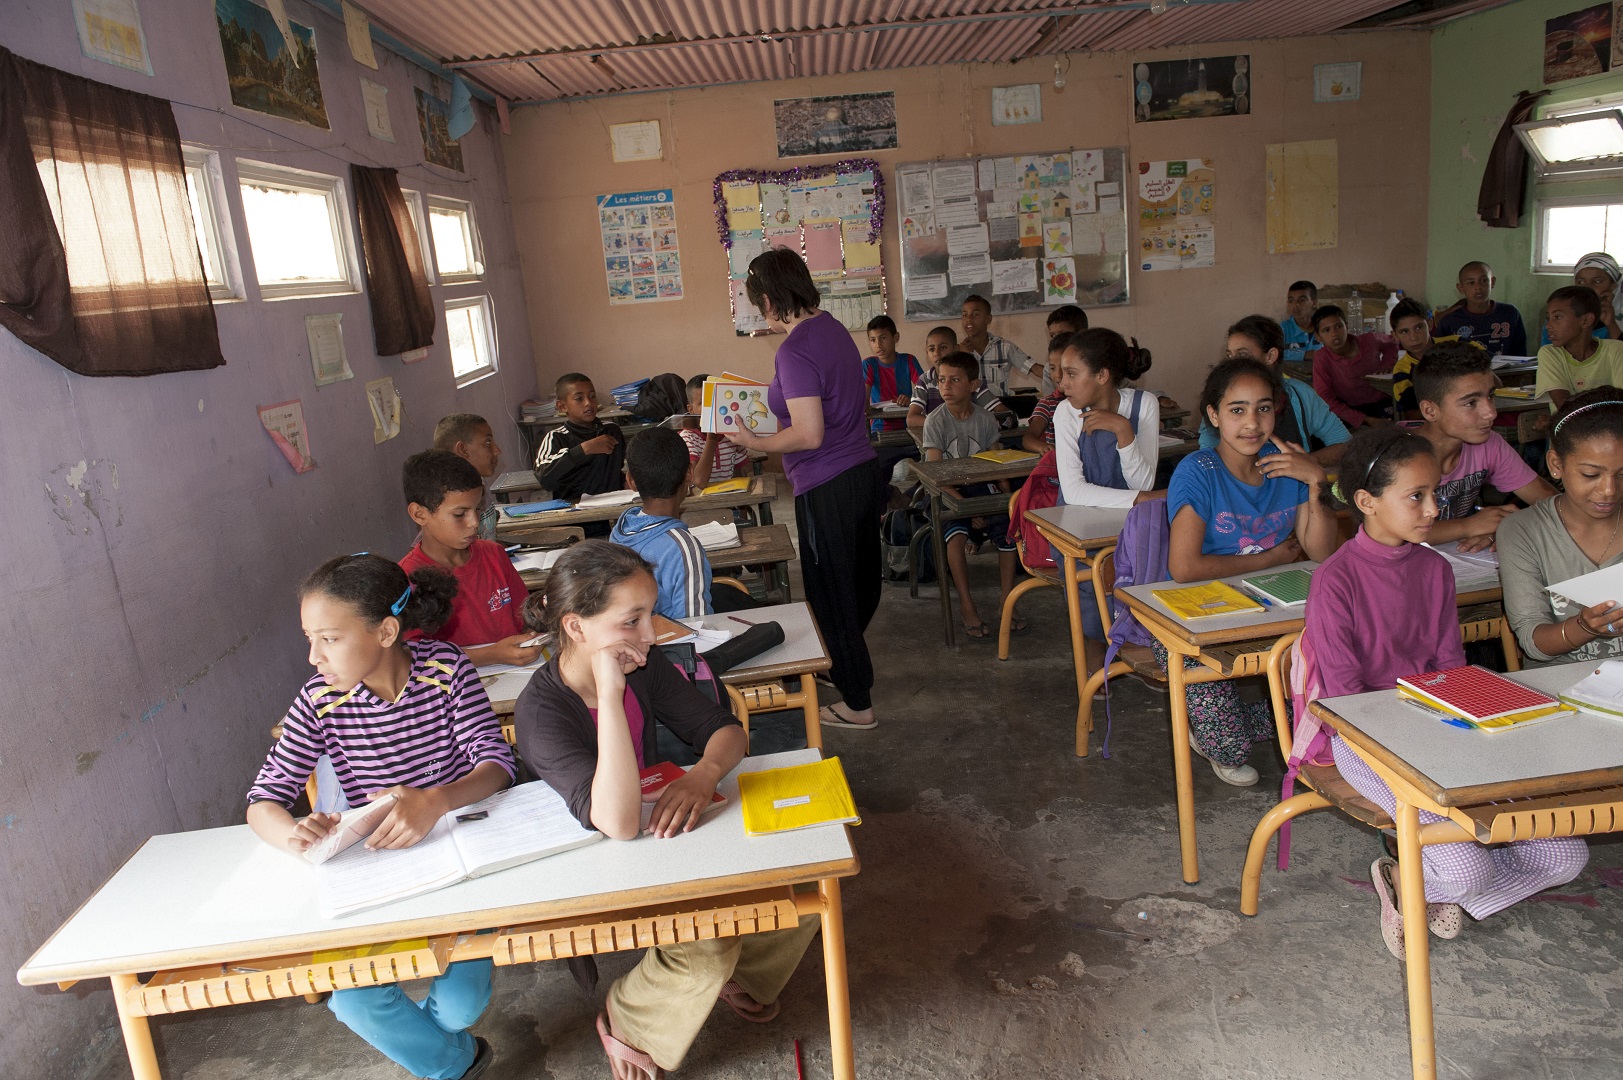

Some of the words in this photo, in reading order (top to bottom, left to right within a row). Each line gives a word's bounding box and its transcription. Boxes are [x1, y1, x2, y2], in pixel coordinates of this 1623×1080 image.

[615, 196, 627, 204] Les
[629, 194, 657, 203] métiers
[1490, 322, 1510, 339] 23
